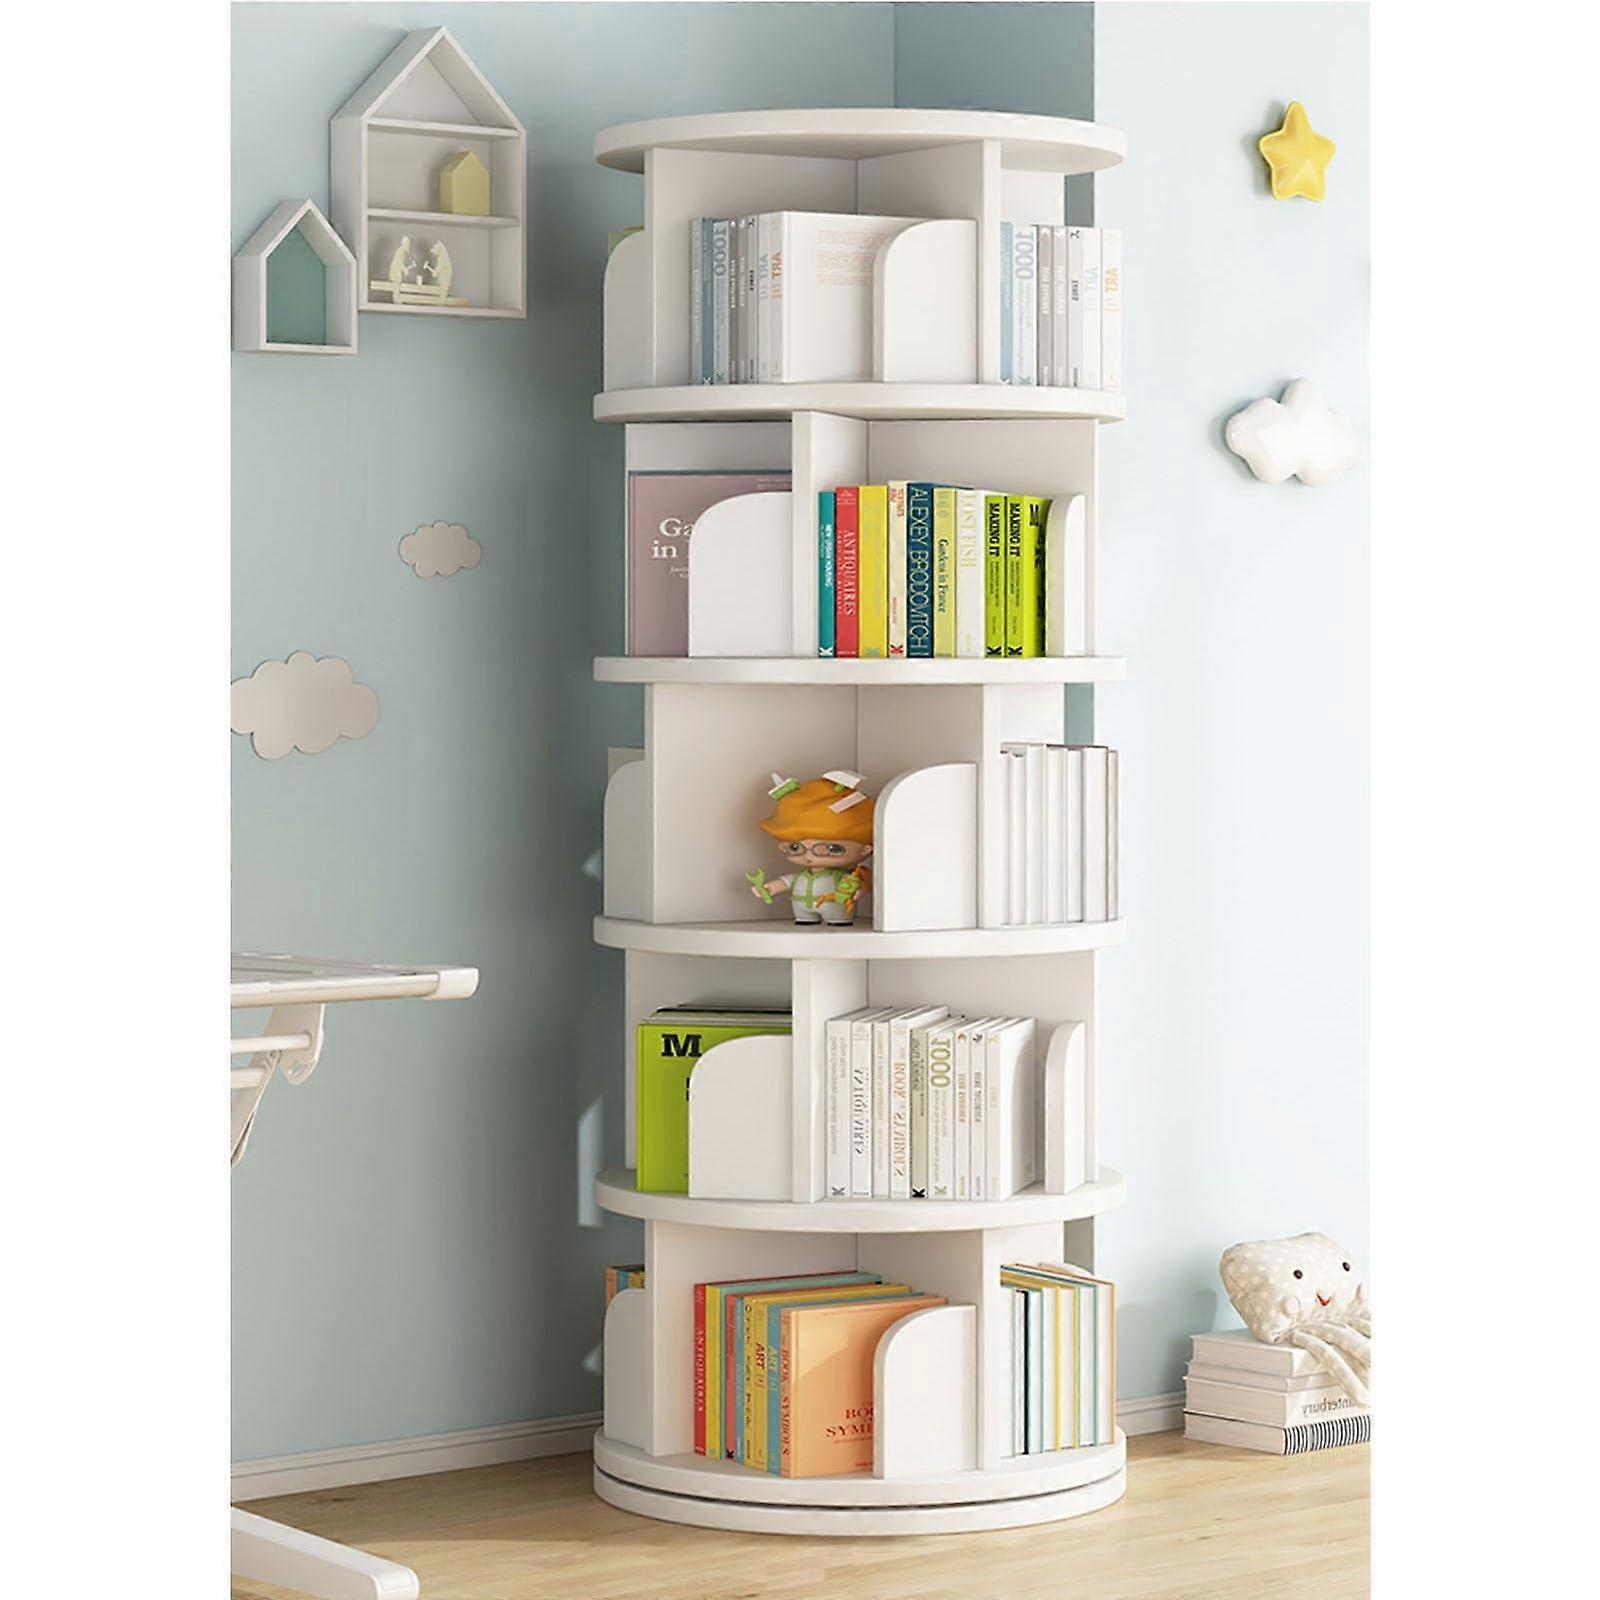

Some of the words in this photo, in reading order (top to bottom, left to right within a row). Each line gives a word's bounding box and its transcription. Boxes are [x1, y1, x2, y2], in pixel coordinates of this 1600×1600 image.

[910, 486, 929, 546] ALEXEY
[989, 503, 1000, 544] MAKING
[1009, 503, 1021, 544] MAKING
[651, 540, 678, 559] in
[989, 546, 1000, 557] IT
[1009, 546, 1021, 557] IT
[842, 529, 856, 616] ANTIQUAIRES
[910, 551, 929, 648] BRODOVITCH
[661, 1034, 703, 1057] M
[755, 1342, 765, 1370] ART
[768, 1346, 778, 1372] ART
[781, 1349, 790, 1383] BOOK
[845, 1407, 873, 1419] BO
